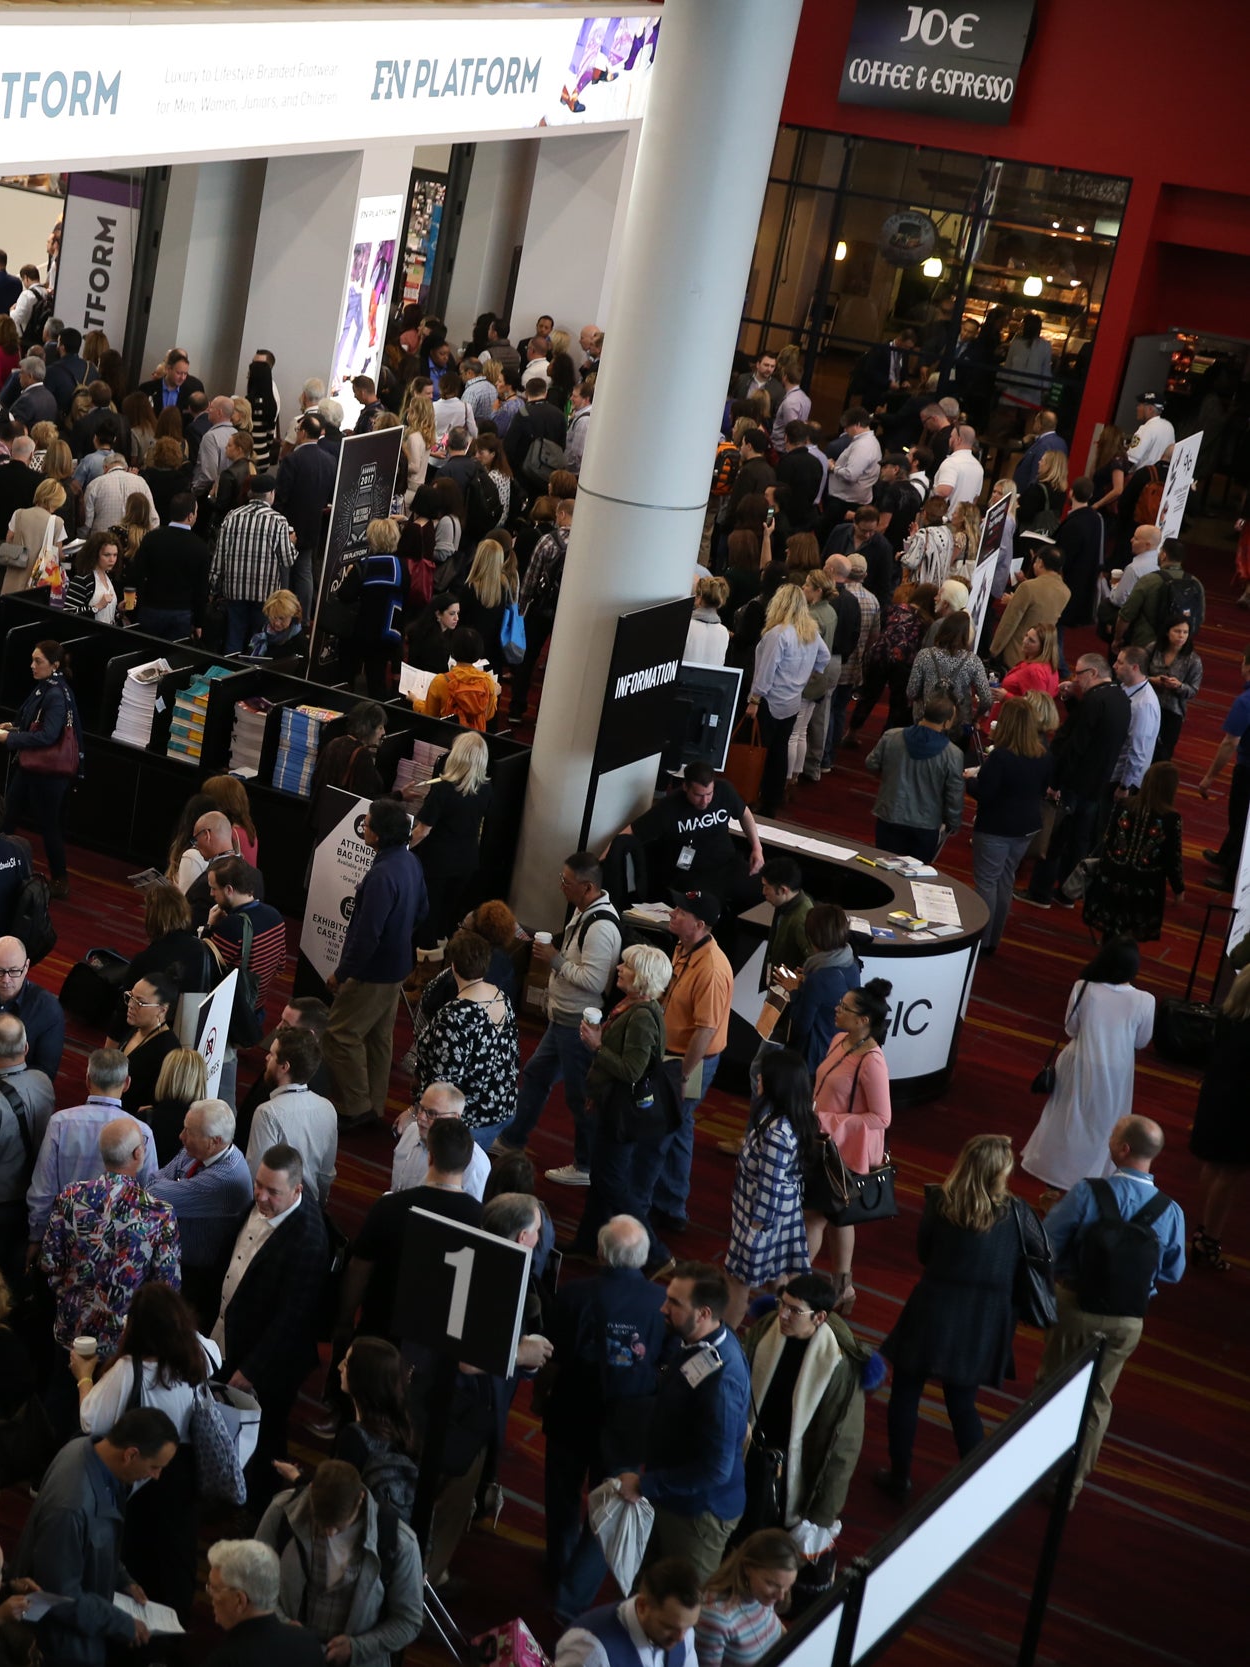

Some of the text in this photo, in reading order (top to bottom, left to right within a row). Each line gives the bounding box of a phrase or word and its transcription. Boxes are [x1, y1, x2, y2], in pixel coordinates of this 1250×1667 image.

[900, 5, 980, 49] JOE
[370, 56, 542, 101] FN PLATFORM
[848, 58, 1015, 104] COFFEE & ESPRESSO
[83, 215, 118, 332] TFORM
[360, 474, 374, 486] 2017
[614, 659, 679, 700] INFORMATION
[678, 808, 729, 834] MAGIC
[336, 847, 353, 860] BAG
[340, 838, 377, 858] ATTENDE
[312, 913, 348, 934] EXHIBITO
[316, 926, 338, 941] CASE
[444, 1246, 476, 1340] 1
